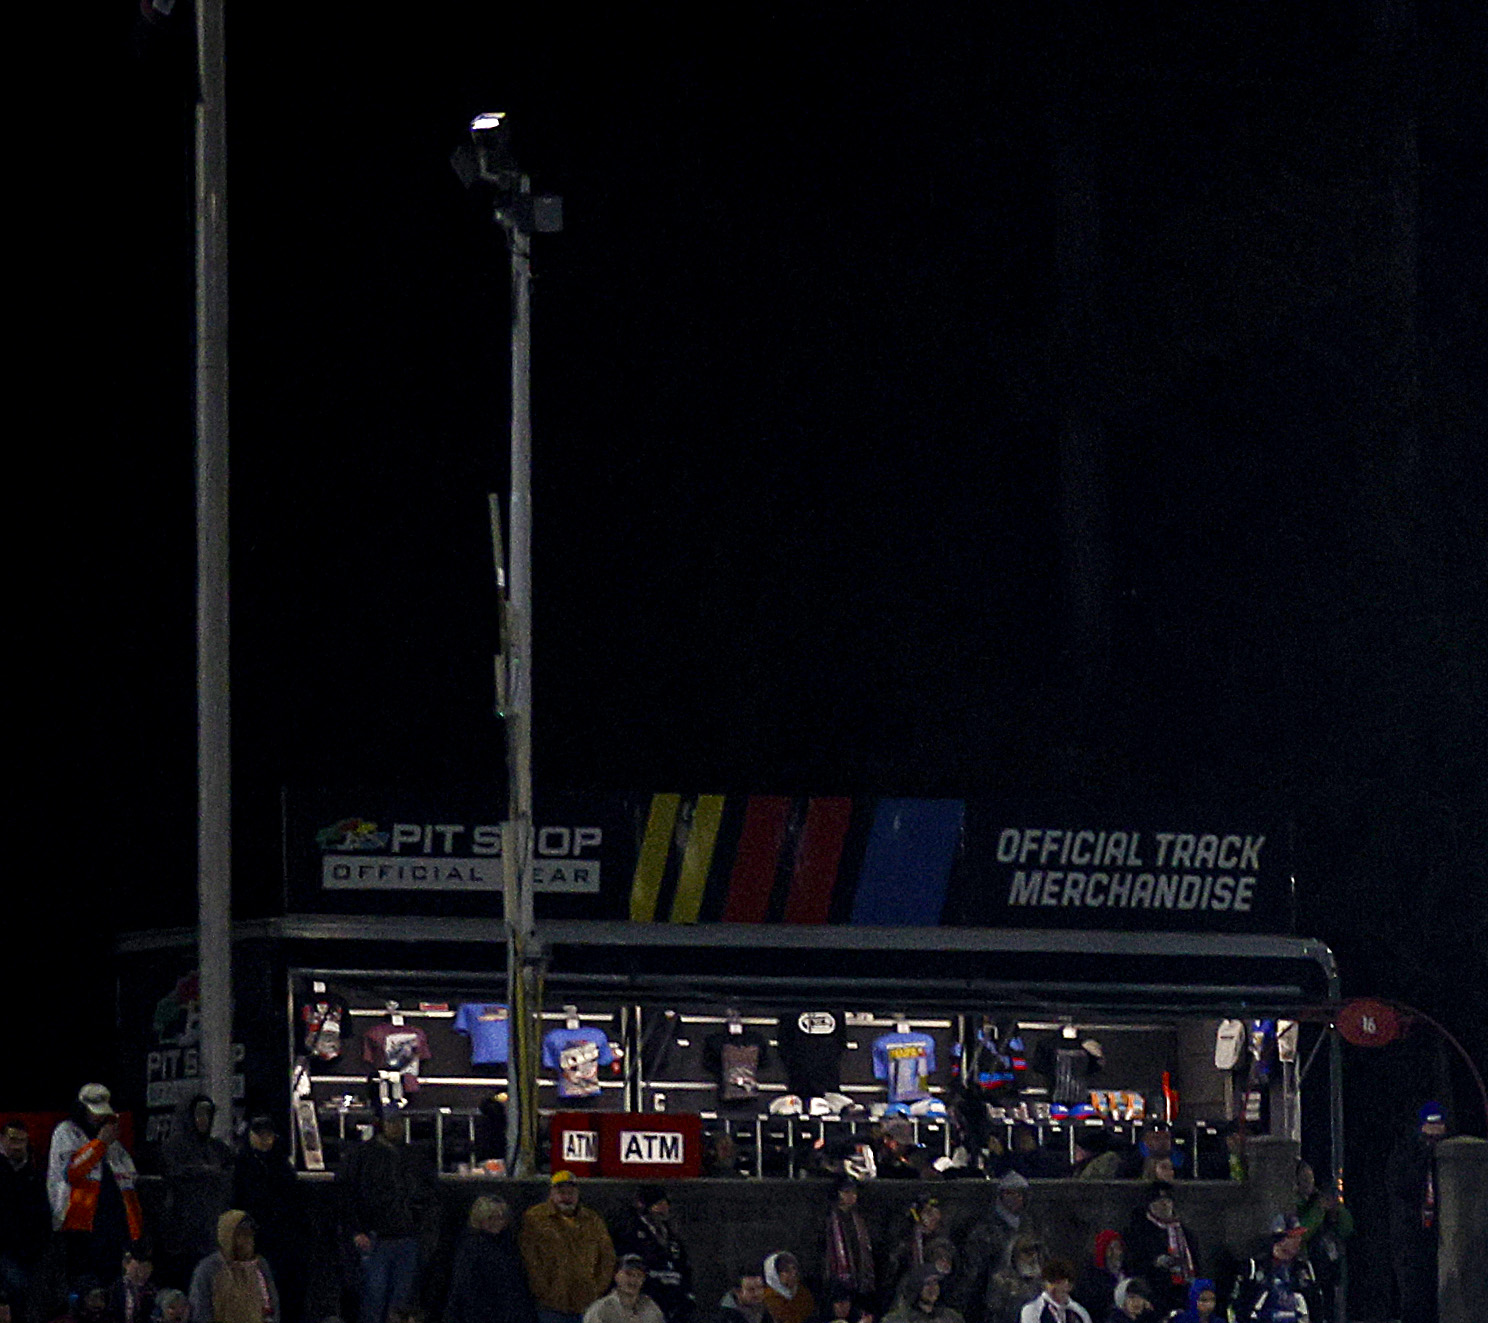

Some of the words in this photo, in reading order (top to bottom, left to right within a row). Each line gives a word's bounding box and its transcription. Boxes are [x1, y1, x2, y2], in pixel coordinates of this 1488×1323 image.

[392, 823, 464, 853] PIT
[472, 824, 602, 857] SOP
[996, 828, 1143, 866] OFFICIAL
[1155, 833, 1266, 870] TRACK
[333, 864, 484, 882] OFFICIAL
[1007, 870, 1257, 912] MERCHANDISE
[624, 1134, 680, 1161] ATM
